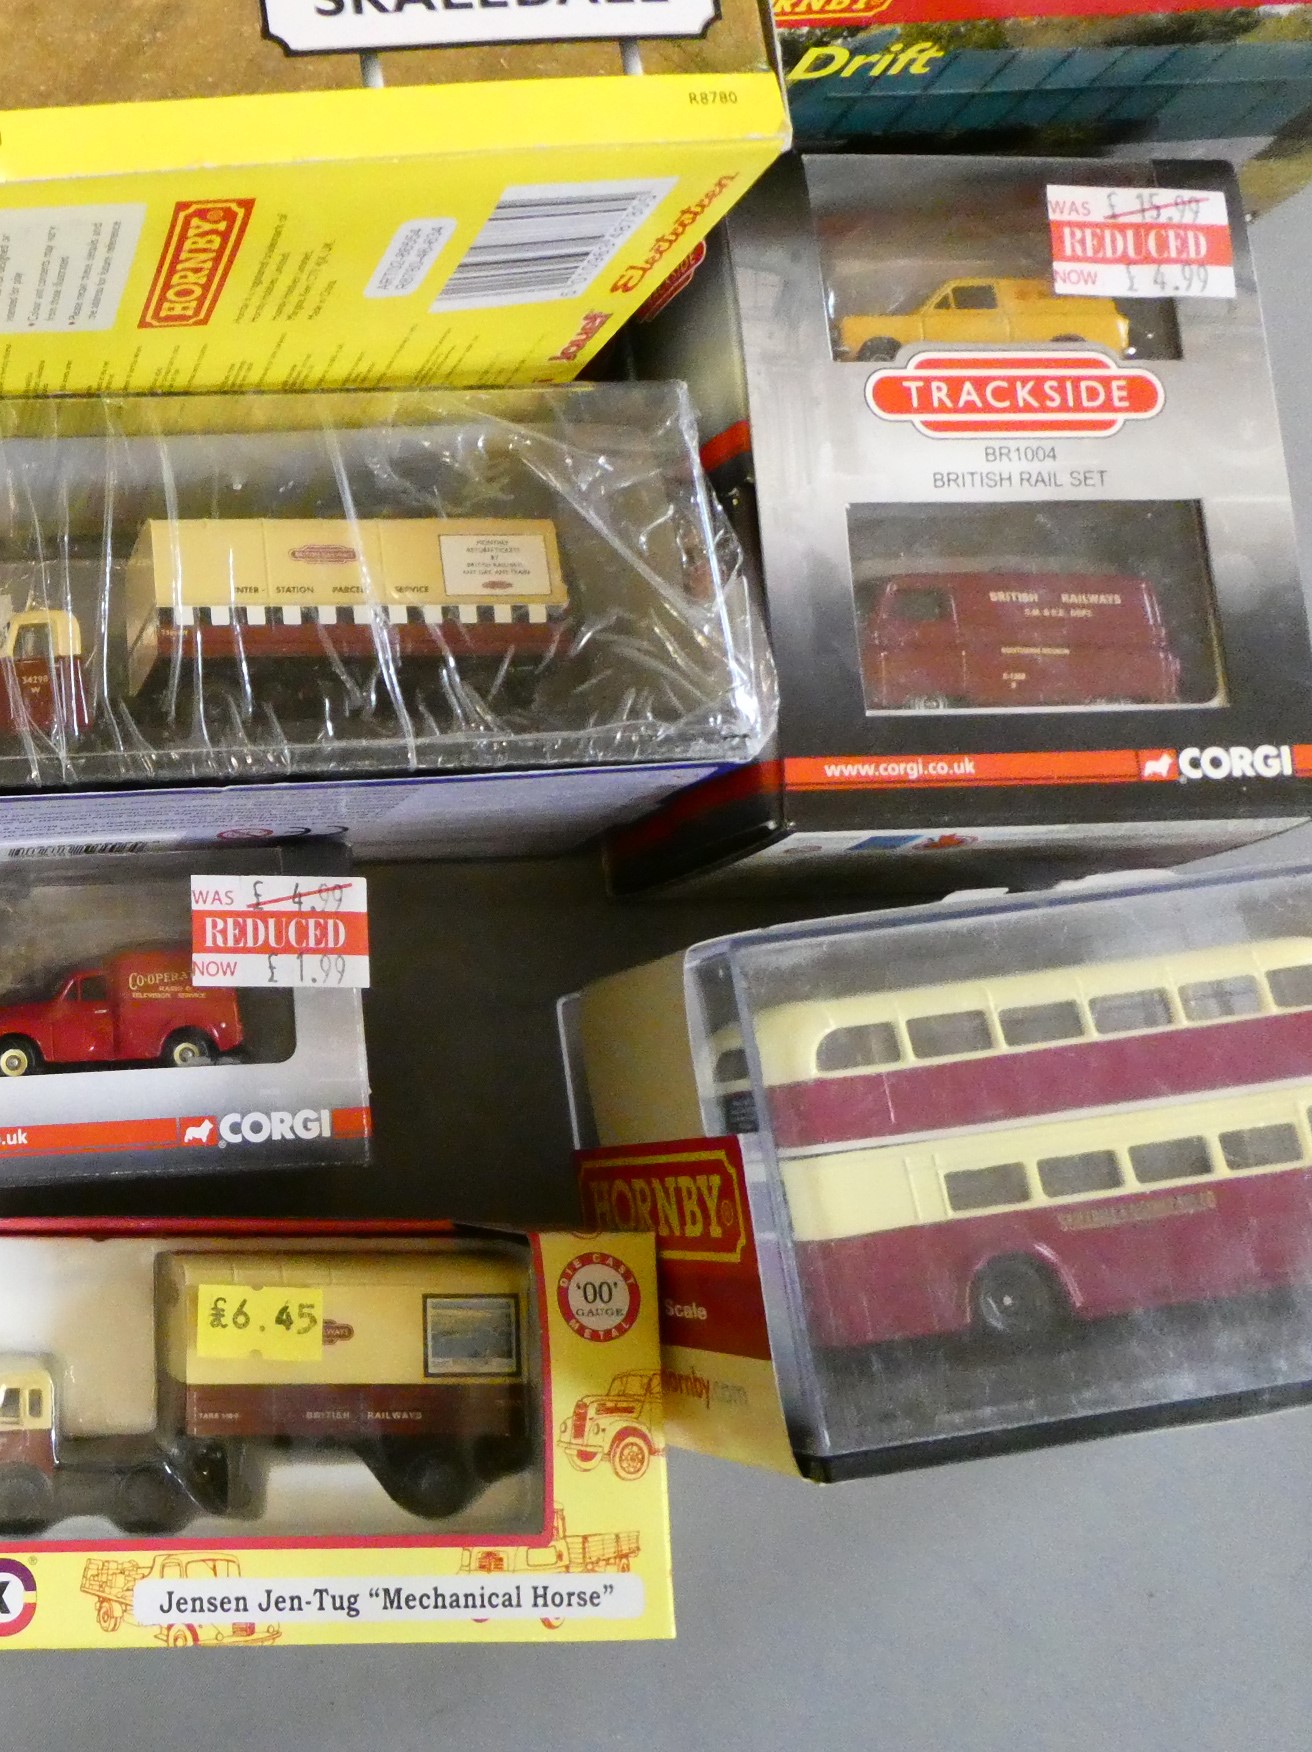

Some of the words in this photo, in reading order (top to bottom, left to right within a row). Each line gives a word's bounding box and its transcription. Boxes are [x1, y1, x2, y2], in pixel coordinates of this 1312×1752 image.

[786, 42, 945, 80] Drift
[688, 91, 738, 105] R8780
[1049, 200, 1091, 217] WAS
[1063, 226, 1207, 260] REDUCED
[159, 217, 228, 317] HORNBY
[1054, 269, 1098, 285] NOW
[902, 378, 1130, 409] TRACKSIDE
[984, 446, 1057, 463] BR1004
[933, 471, 1012, 489] BRITISH
[1019, 471, 1063, 488] RAIL
[1070, 470, 1108, 488] SET
[276, 585, 314, 595] STATION
[1060, 593, 1122, 605] RAILWAYS
[824, 757, 975, 780] www.corgi.co.uk
[1179, 744, 1293, 780] CORGI
[192, 889, 234, 906] WAS
[204, 917, 346, 948] REDUCED
[192, 961, 238, 977] NOW
[219, 1108, 332, 1145] CORGI
[590, 1174, 724, 1238] HORNBY
[559, 1259, 582, 1287] DIE
[592, 1253, 635, 1283] CAST
[576, 1308, 624, 1317] GAUGE
[568, 1319, 629, 1340] METAL
[367, 1411, 423, 1420] RAILWAYS
[159, 1591, 248, 1614] Jensen
[258, 1589, 360, 1618] Jen-Tug
[368, 1584, 523, 1610] "Mechanical
[531, 1583, 615, 1607] Horse"
